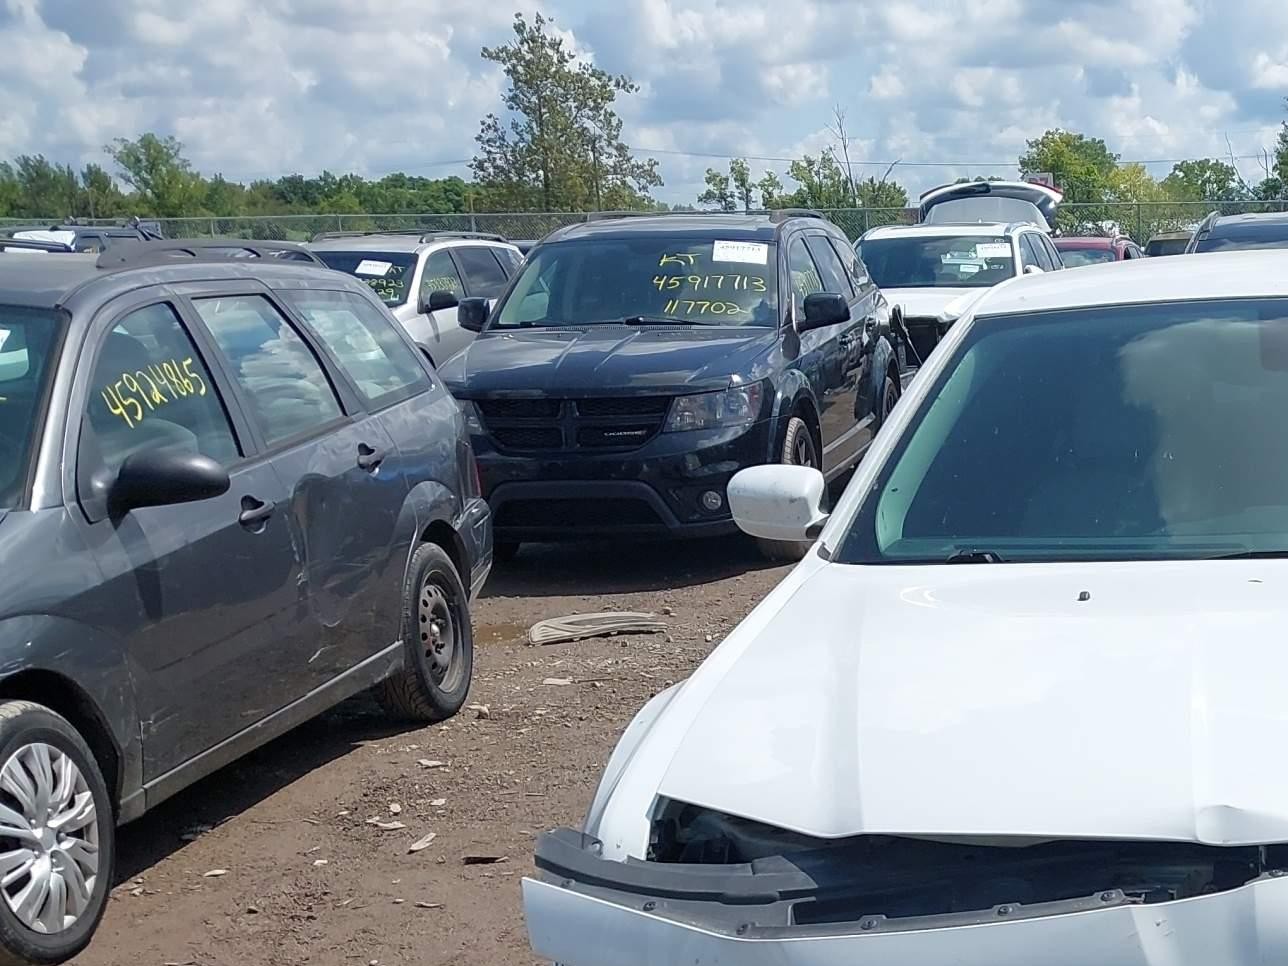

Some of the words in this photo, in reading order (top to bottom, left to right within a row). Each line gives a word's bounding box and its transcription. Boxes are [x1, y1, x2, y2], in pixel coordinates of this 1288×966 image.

[659, 253, 703, 267] KT
[652, 274, 767, 292] 45917713
[663, 299, 751, 315] 117702
[101, 357, 206, 429] 45924865
